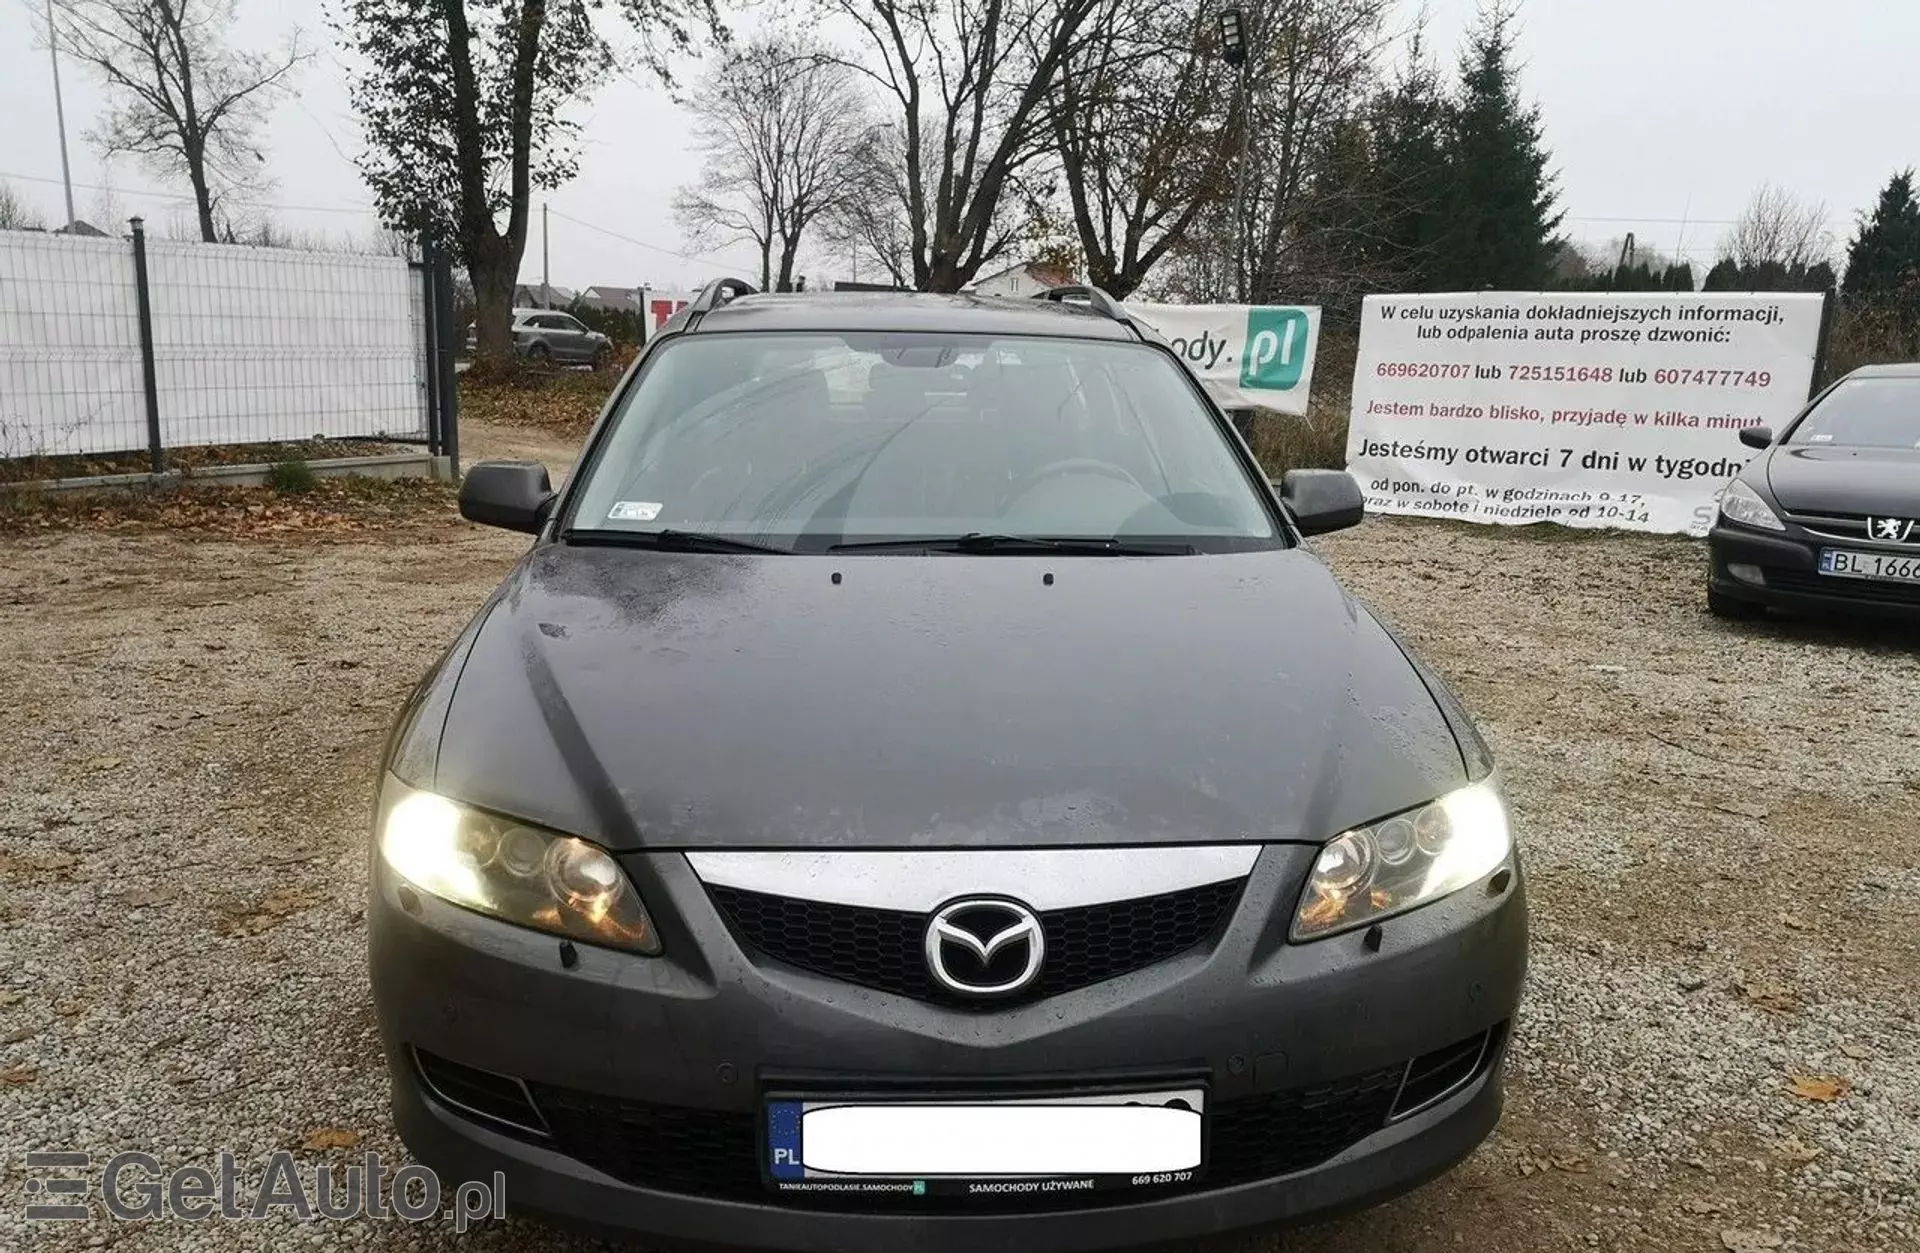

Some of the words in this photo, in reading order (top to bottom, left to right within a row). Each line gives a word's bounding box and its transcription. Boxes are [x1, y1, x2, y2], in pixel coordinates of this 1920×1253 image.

[1381, 305, 1397, 319] W
[1400, 305, 1434, 320] celu
[1439, 305, 1519, 323] uzyskania
[1526, 305, 1671, 325] dokładniejszych
[1678, 305, 1784, 326] informacji,
[1417, 325, 1441, 339] lub
[1447, 325, 1528, 343] odpalenia
[1534, 327, 1574, 341] auta
[1580, 328, 1641, 345] proszę
[1648, 326, 1731, 343] dzwonić:
[1376, 362, 1471, 379] 669620707
[1475, 364, 1501, 380] lub
[1509, 365, 1613, 383] 725151648
[1619, 368, 1647, 384] lub
[1654, 368, 1771, 387] 607477749
[1367, 400, 1425, 417] Jestem
[1430, 403, 1483, 419] bardzo
[1489, 405, 1545, 424] blisko,
[1551, 408, 1627, 428] przyjadę
[1634, 414, 1648, 425] w
[1654, 410, 1699, 428] kilka
[1706, 414, 1763, 429] minut
[1358, 439, 1459, 466] Jesteśmy
[1465, 446, 1550, 467] otwarci
[1560, 449, 1573, 468] 7
[1581, 450, 1619, 470] dni
[1628, 457, 1647, 472] w
[1655, 455, 1750, 480] tygodn
[1371, 478, 1389, 491] od
[1393, 481, 1425, 495] pon.
[1430, 482, 1451, 494] do
[1457, 485, 1478, 497] pt.
[1486, 488, 1499, 499] w
[1503, 488, 1592, 504] godzinach
[1398, 499, 1410, 508] w
[1596, 506, 1649, 523] 10-14
[1835, 553, 1862, 573] BL
[774, 1148, 800, 1165] PL
[969, 1182, 1040, 1193] SAMOCHODY
[1042, 1179, 1094, 1192] UŻYWANE
[1132, 1175, 1150, 1185] 669
[1153, 1174, 1172, 1184] 620
[1174, 1172, 1192, 1182] 707
